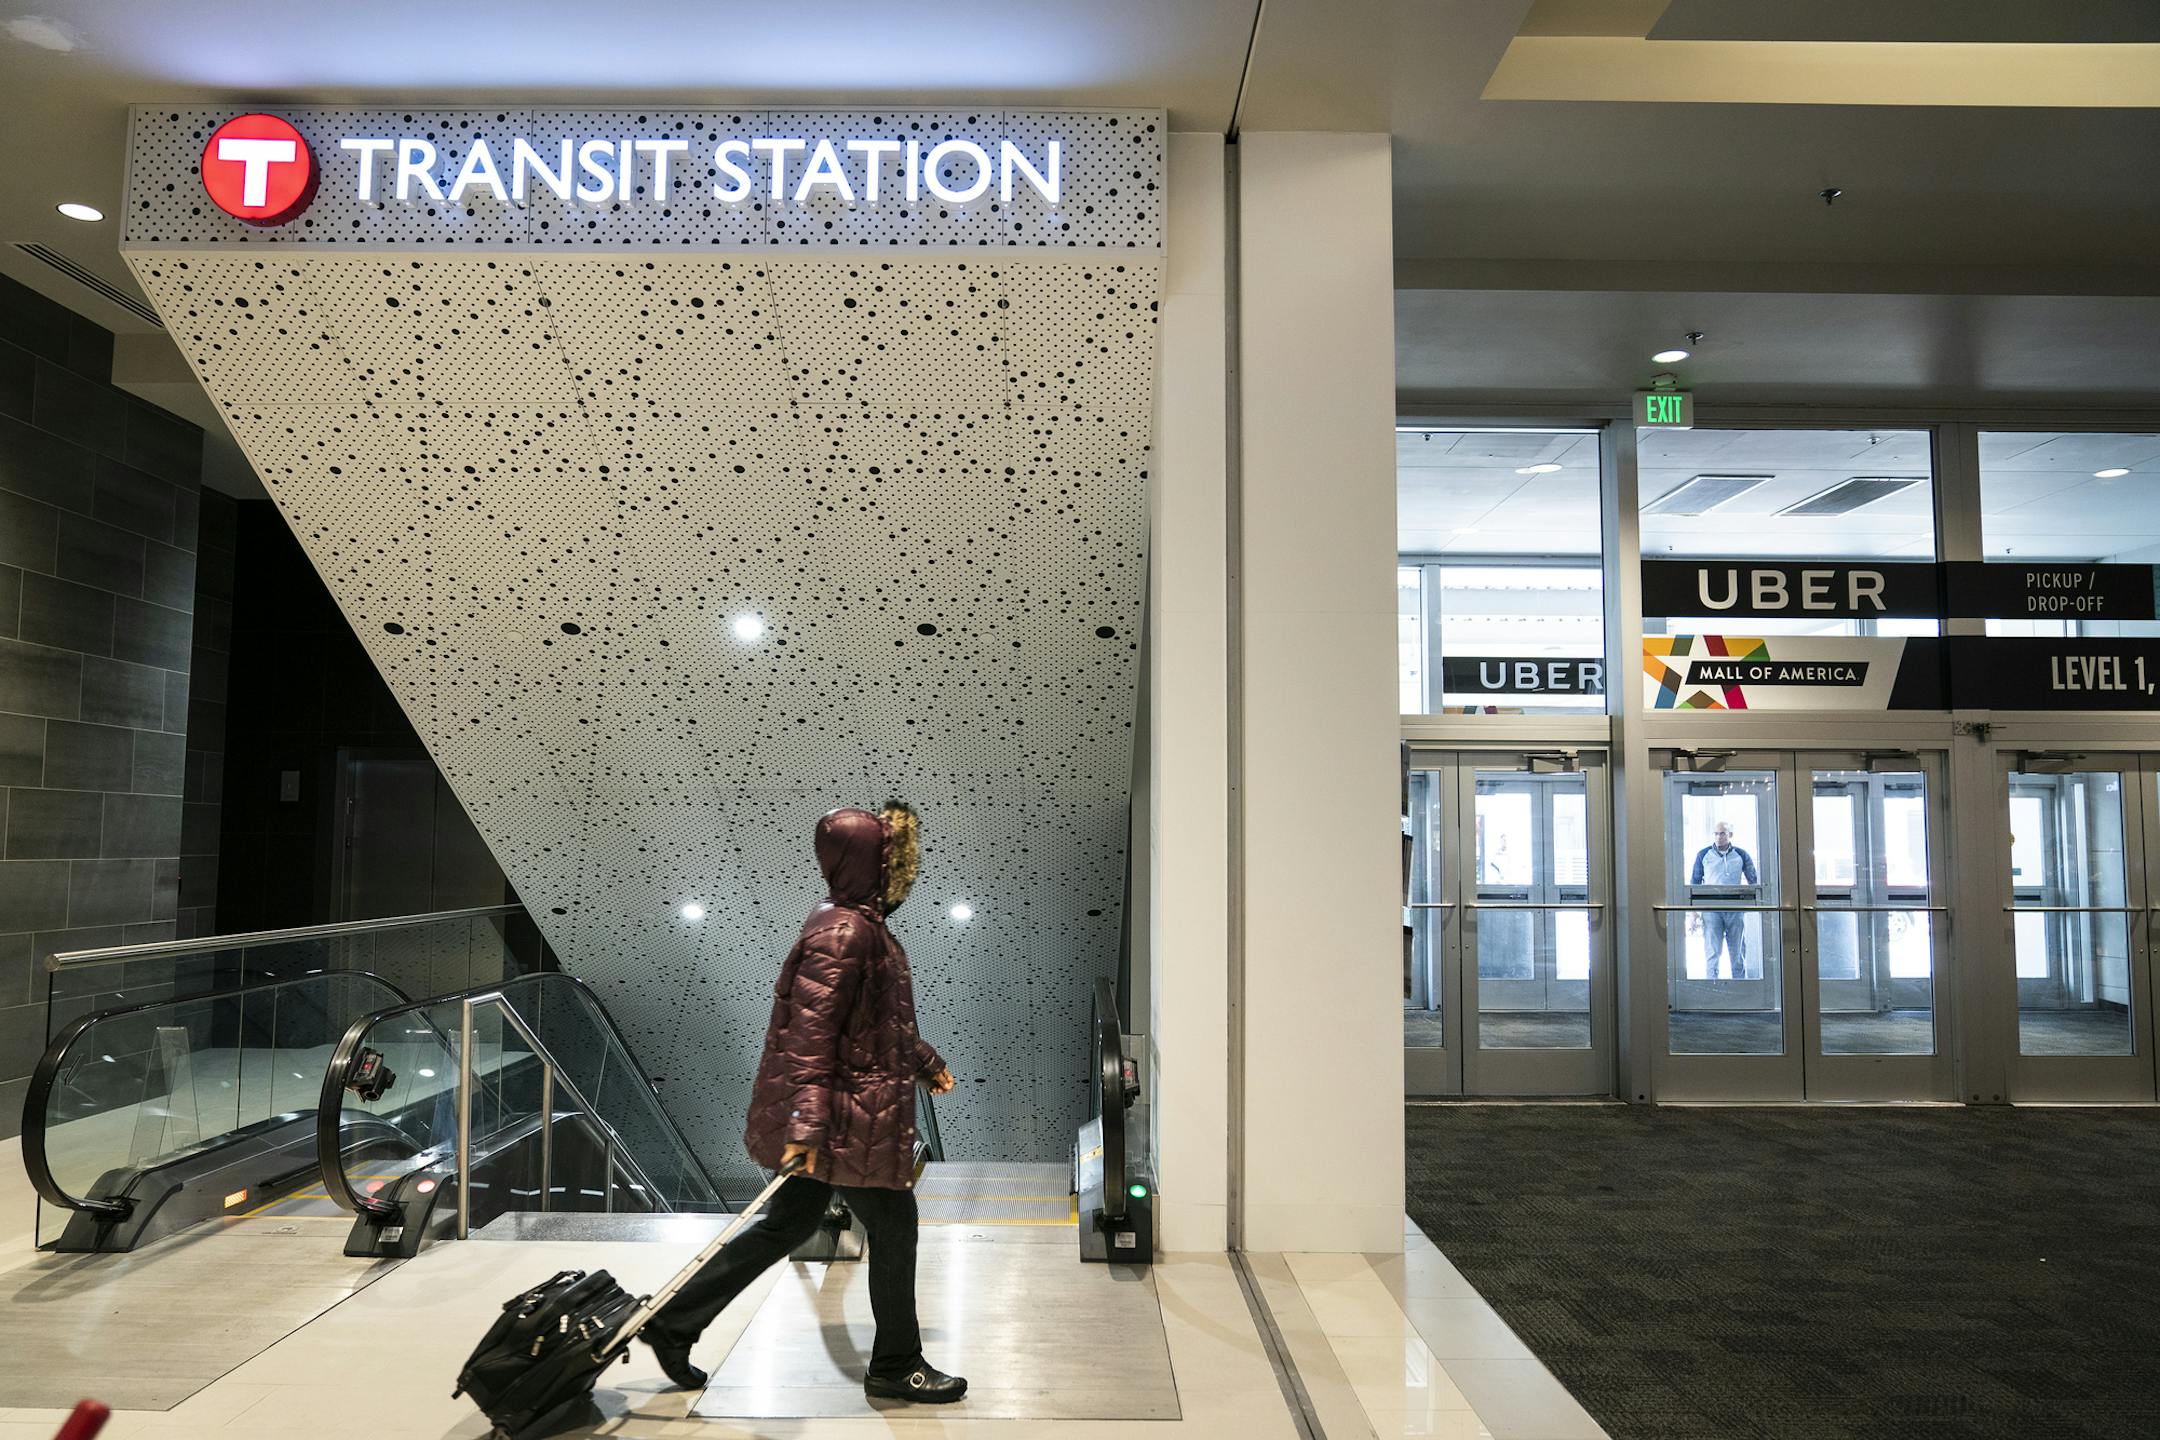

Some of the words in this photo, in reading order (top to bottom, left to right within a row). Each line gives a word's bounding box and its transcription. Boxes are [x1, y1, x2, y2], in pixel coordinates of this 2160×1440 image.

[217, 137, 297, 208] T
[340, 138, 690, 203] TRANSIT
[713, 138, 1061, 205] STATION
[1647, 395, 1683, 423] EXIT
[1698, 568, 1887, 611] UBER
[2026, 572, 2083, 589] PICKUP
[2089, 571, 2095, 590] /
[2027, 596, 2105, 612] DROP-OFF
[1479, 661, 1604, 690] UBER
[1700, 666, 1744, 680] MALL
[1749, 666, 1773, 680] OF
[2051, 656, 2127, 690] LEVEL
[2134, 656, 2155, 695] 1,
